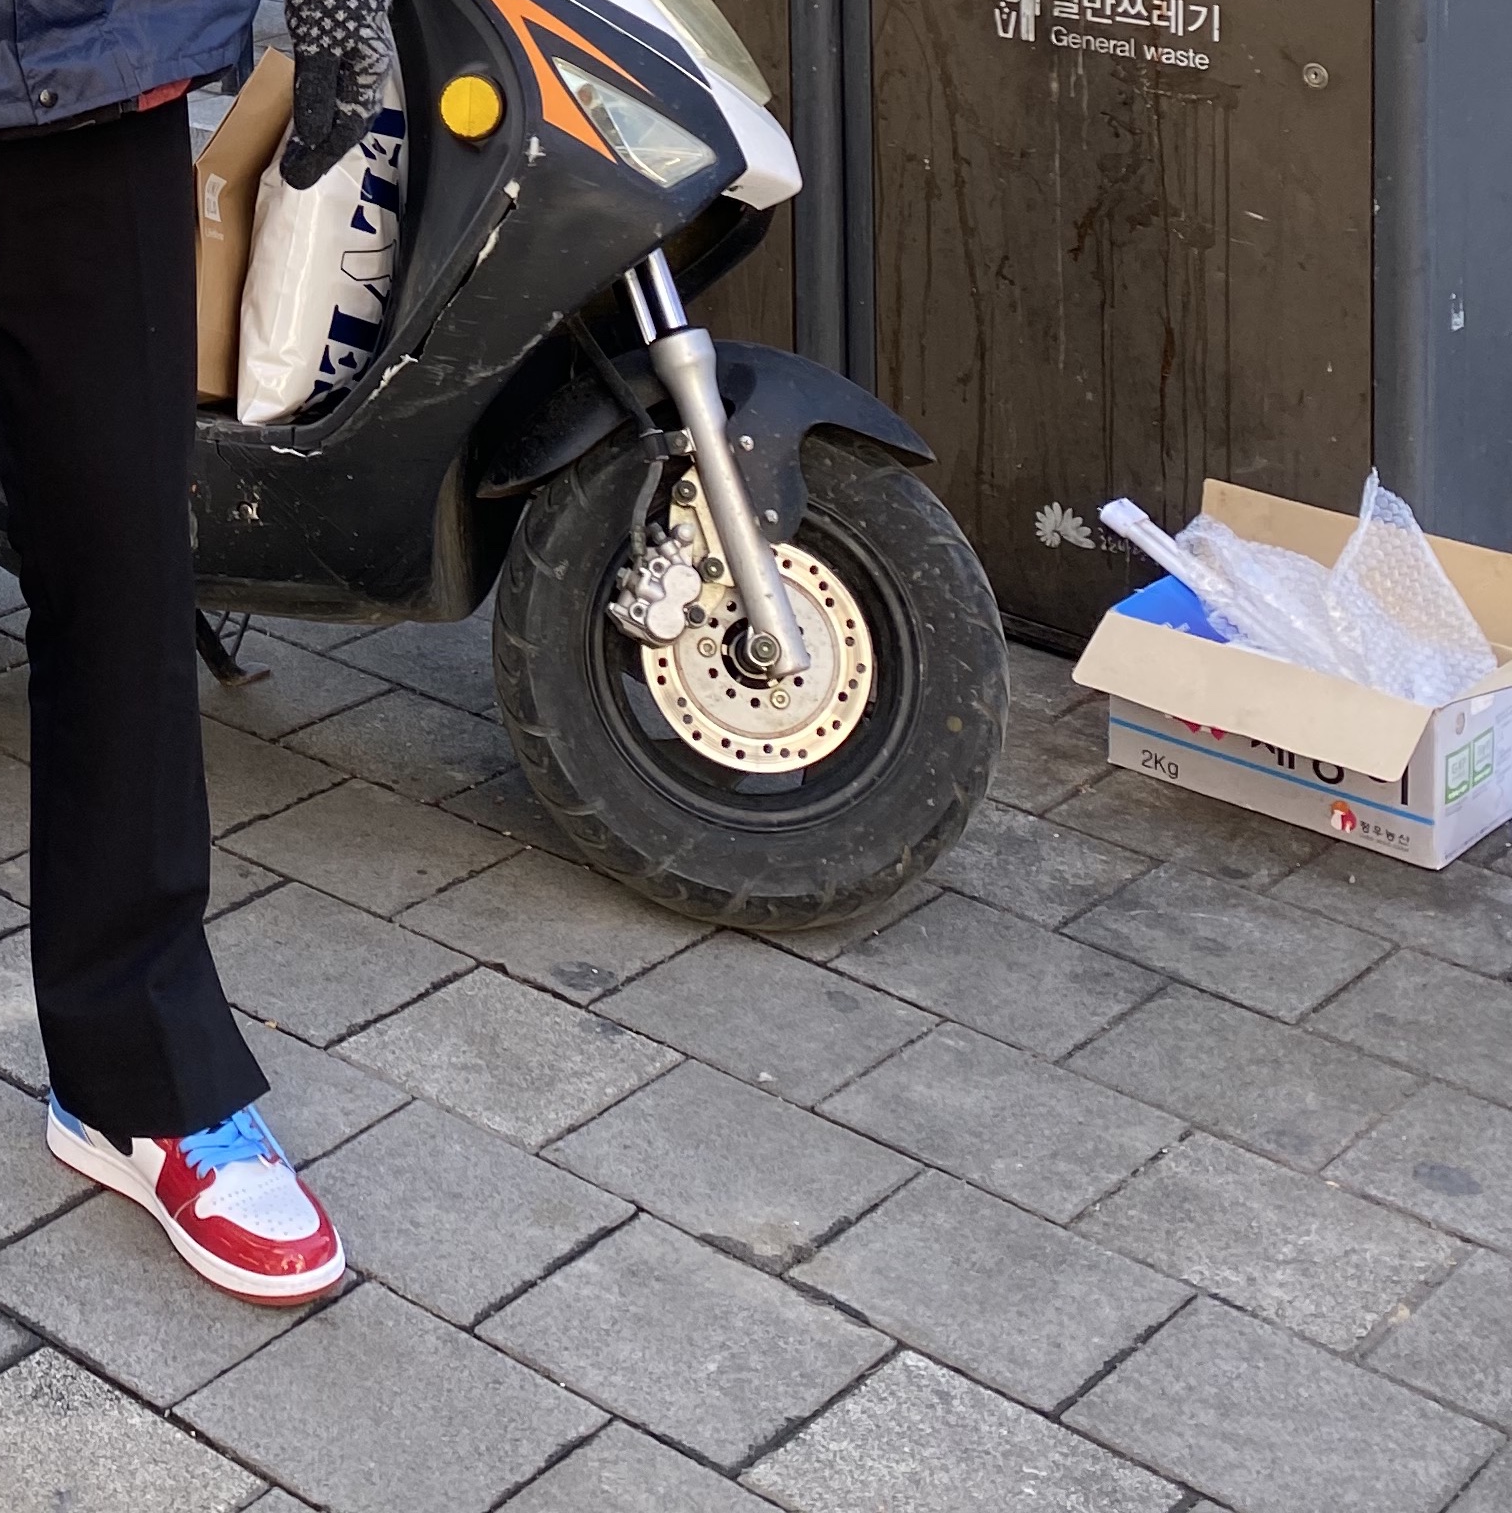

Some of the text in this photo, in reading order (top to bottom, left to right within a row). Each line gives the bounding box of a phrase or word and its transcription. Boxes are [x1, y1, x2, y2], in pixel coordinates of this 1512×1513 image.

[1050, 26, 1210, 70] General waste
[1140, 749, 1179, 780] 2Kg
